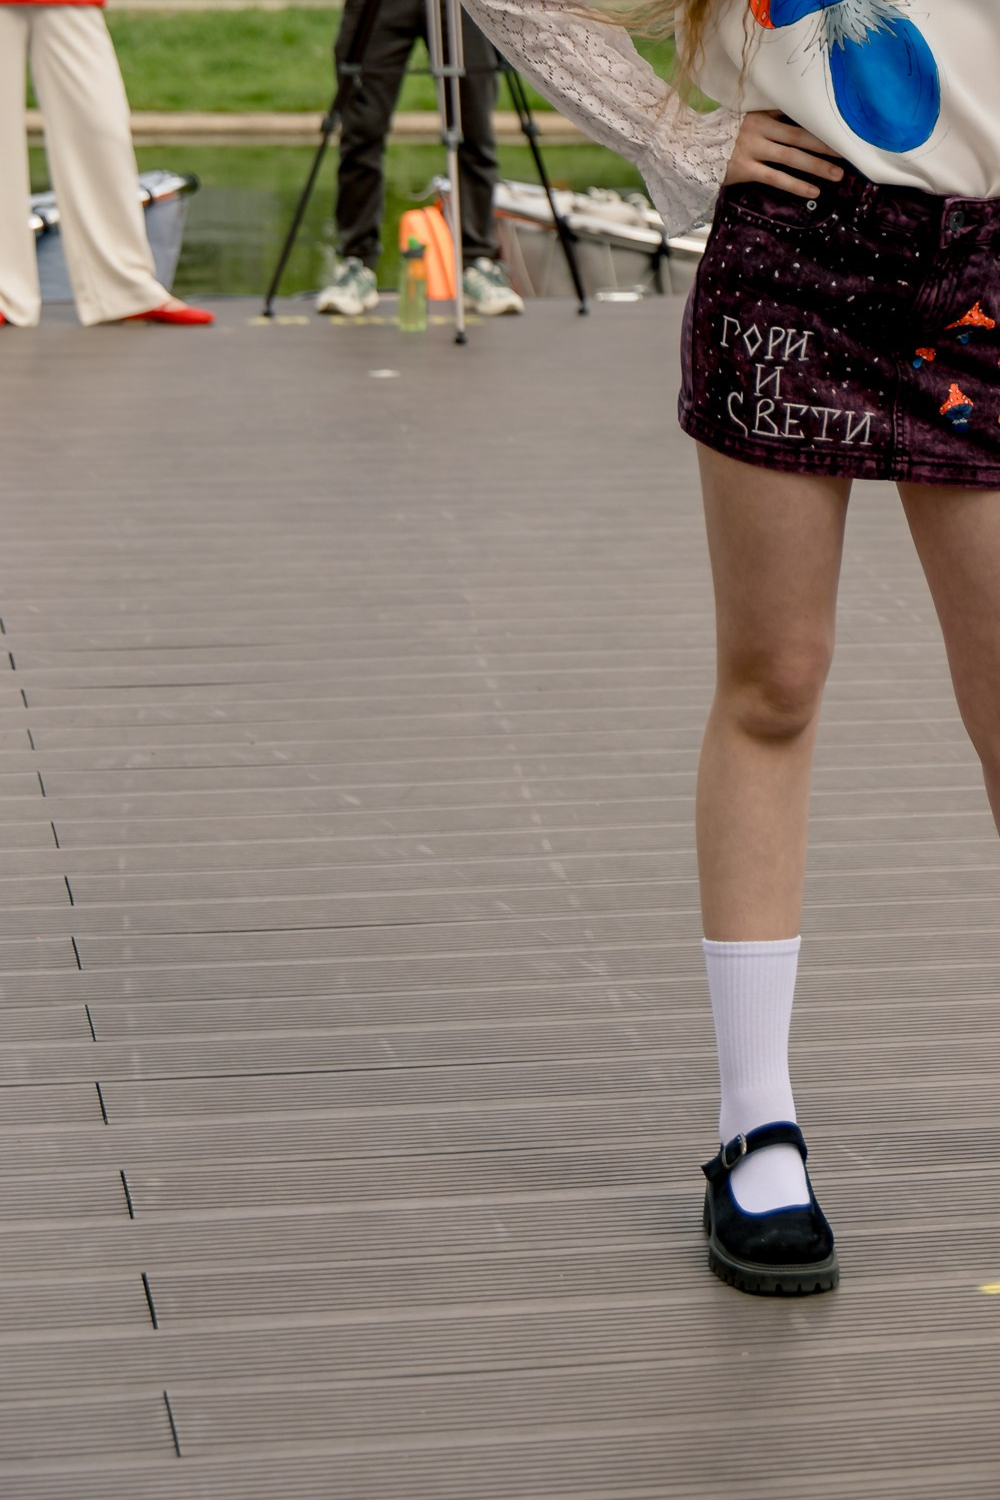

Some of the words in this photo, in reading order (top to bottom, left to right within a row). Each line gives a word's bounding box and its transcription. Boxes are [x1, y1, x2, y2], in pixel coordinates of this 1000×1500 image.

[720, 316, 814, 361] ГОРИ
[754, 363, 784, 399] И
[727, 392, 876, 445] СВЕТИ
